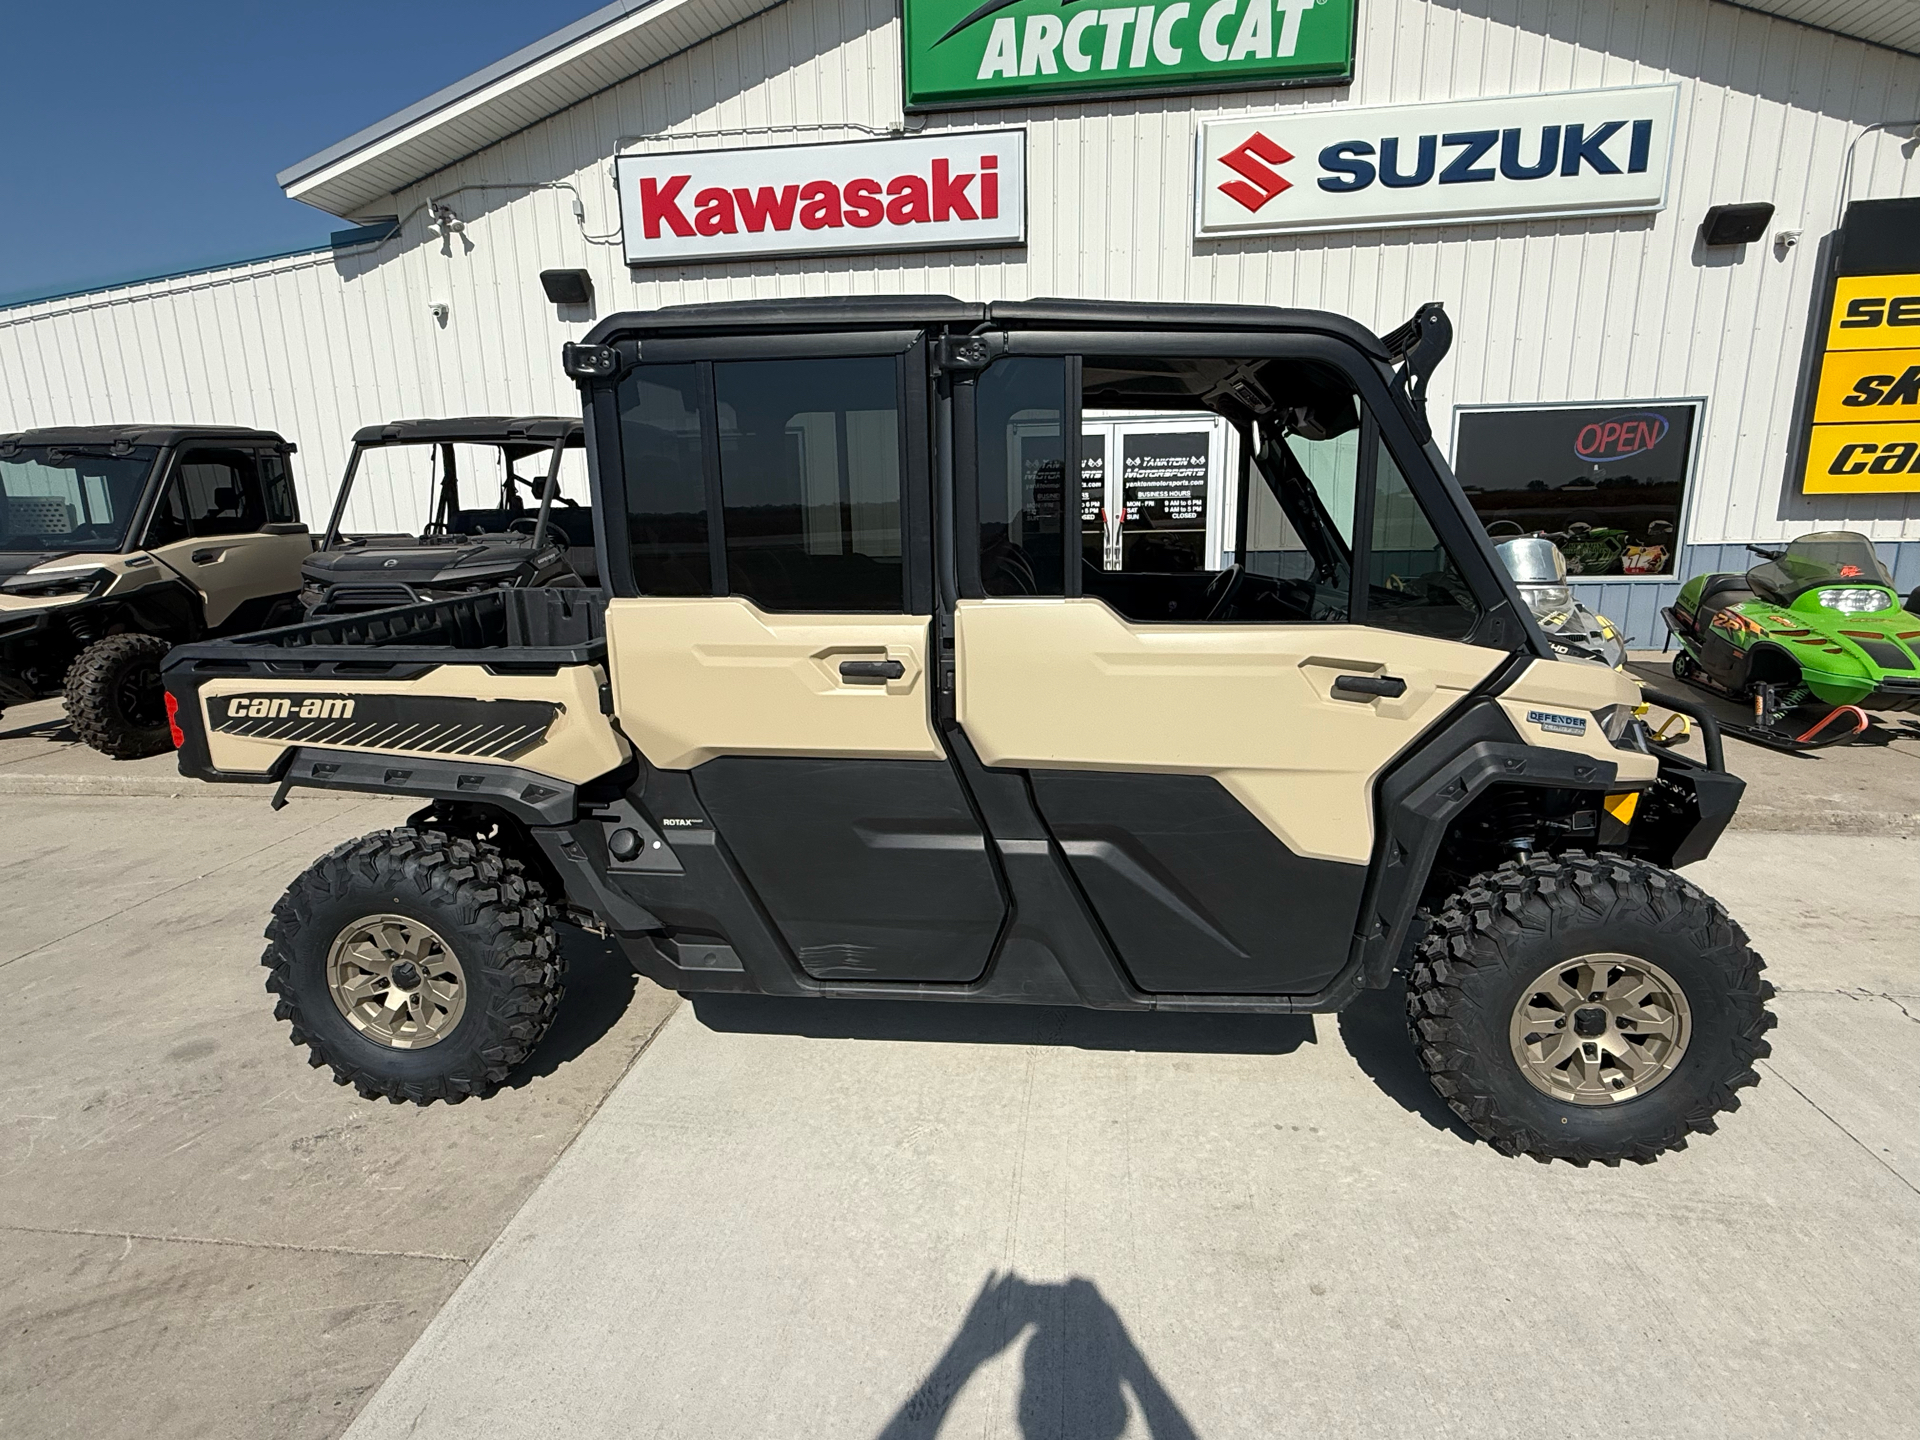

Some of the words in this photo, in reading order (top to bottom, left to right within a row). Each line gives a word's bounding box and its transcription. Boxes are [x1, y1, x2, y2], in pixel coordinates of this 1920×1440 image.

[976, 2, 1190, 80] ARCTIC
[1200, 0, 1314, 62] CAT
[1317, 119, 1653, 193] SUZUKI
[640, 155, 998, 239] Kawasaki
[1576, 420, 1660, 455] OPEN
[1143, 456, 1189, 467] YANKTON
[1124, 468, 1206, 478] MOTORSPORTS
[1125, 480, 1204, 489] yanktonmotorsports.com
[227, 698, 356, 719] can-am
[1529, 711, 1586, 727] DEFENDER
[663, 818, 692, 826] ROTAX
